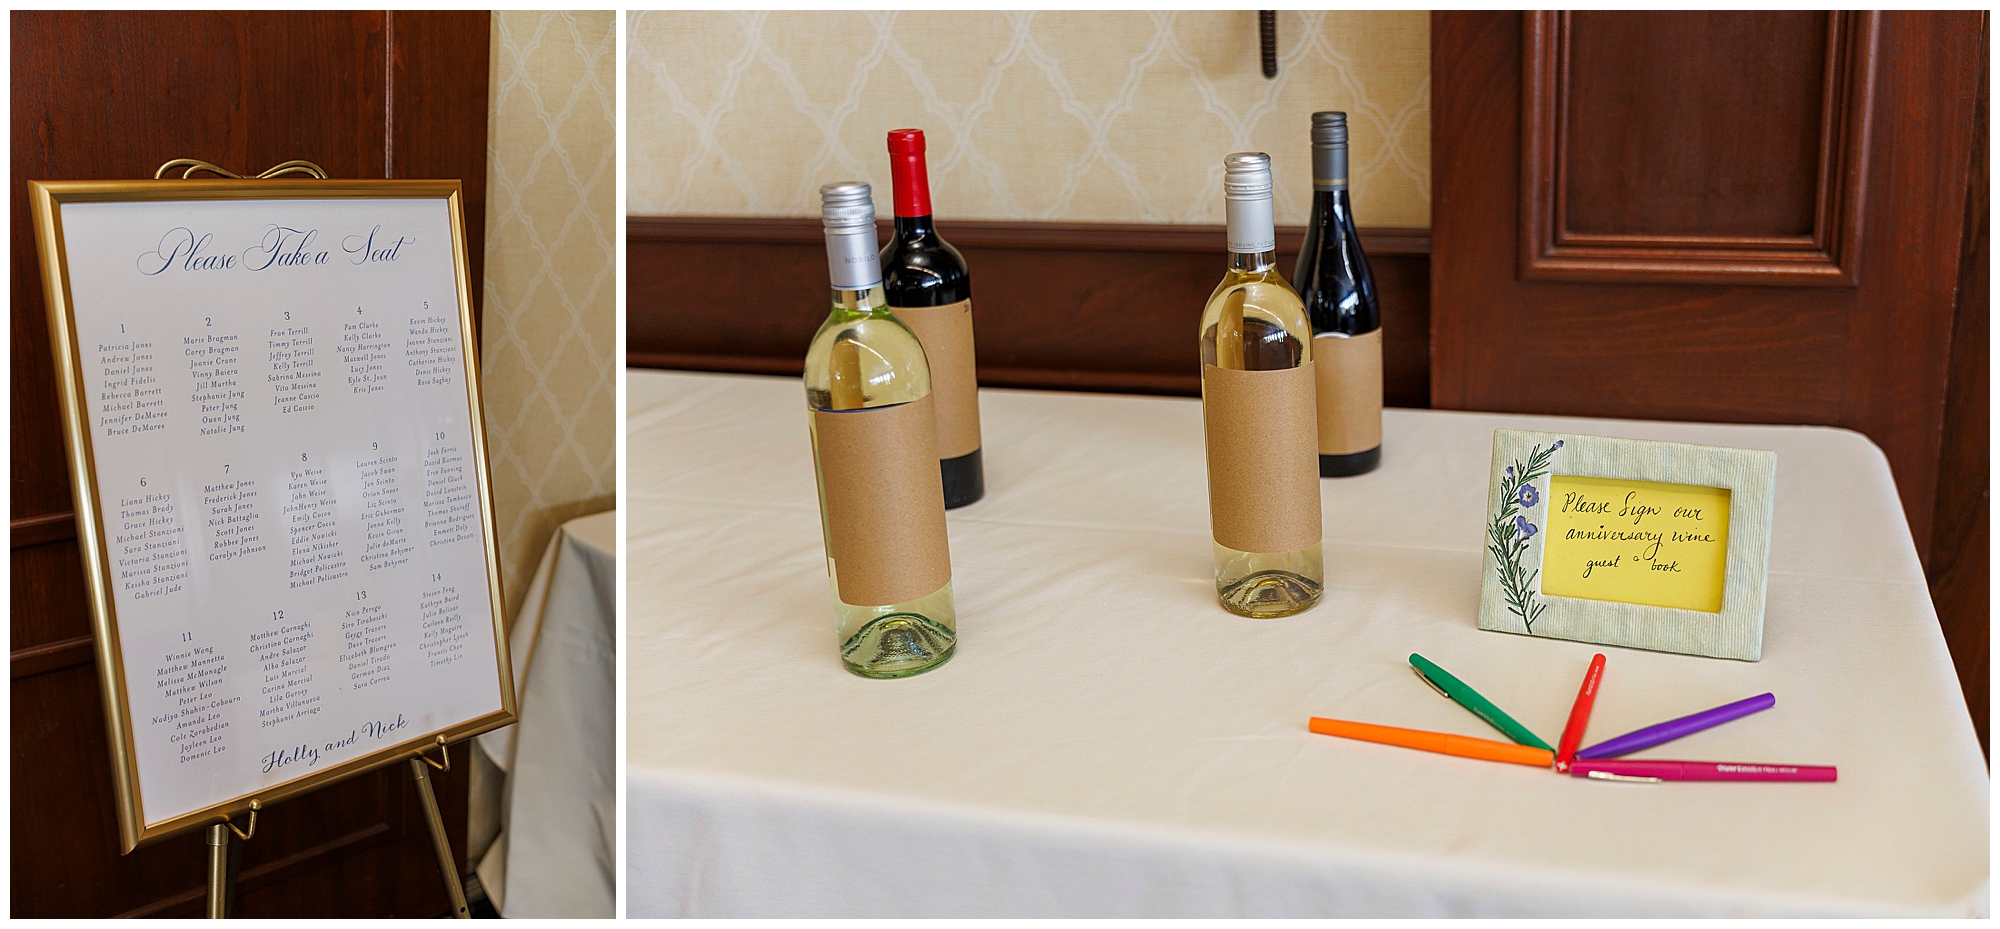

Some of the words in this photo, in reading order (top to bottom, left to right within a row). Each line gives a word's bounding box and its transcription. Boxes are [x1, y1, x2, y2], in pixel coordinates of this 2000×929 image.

[136, 226, 237, 275] Please
[242, 223, 318, 271] Take
[315, 249, 330, 265] a
[341, 224, 416, 266] Seat
[845, 254, 876, 264] NOBILO
[357, 306, 362, 314] 4
[205, 317, 212, 326] 2
[284, 312, 290, 320] 3
[428, 316, 446, 324] Hickey
[121, 324, 125, 333] 1
[288, 327, 308, 335] Terrill
[430, 326, 448, 335] Hickey
[268, 340, 290, 348] Timmy
[292, 338, 313, 346] Terrill
[344, 334, 359, 342] Kelly
[406, 338, 425, 347] Jeanne
[99, 344, 129, 352] Patricia
[132, 342, 152, 351] Jones
[336, 345, 355, 353] Nancy
[357, 342, 391, 351] Harrington
[406, 347, 428, 356] Anthony
[101, 356, 129, 364] Andrew
[132, 354, 152, 362] Jones
[269, 351, 291, 361] Jeffrey
[294, 349, 314, 357] Terrill
[371, 353, 386, 361] Jones
[104, 367, 130, 376] Daniel
[132, 366, 152, 374] Jones
[273, 362, 290, 371] Kelly
[292, 360, 313, 368] Terrill
[351, 365, 364, 374] Lucy
[366, 364, 382, 372] Jones
[433, 366, 451, 374] Hickey
[104, 379, 128, 389] Ingrid
[131, 377, 155, 385] Fidelis
[268, 373, 294, 382] Sabrina
[348, 375, 361, 385] Kyle
[196, 382, 208, 392] Jill
[211, 380, 236, 388] Murtha
[353, 386, 366, 394] Kris
[368, 385, 384, 393] Jones
[102, 391, 131, 400] Rebecca
[135, 388, 162, 397] Barrett
[192, 392, 226, 402] Stephanie
[228, 391, 244, 399] Jung
[103, 403, 133, 412] Michael
[137, 400, 163, 408] Barrett
[202, 404, 219, 412] Peter
[222, 403, 238, 412] Jung
[202, 415, 221, 423] Owen
[224, 414, 240, 422] Jung
[200, 427, 227, 435] Natalie
[229, 424, 245, 434] Jung
[436, 432, 445, 440] 10
[372, 442, 378, 450] 9
[302, 453, 307, 461] 8
[356, 459, 377, 467] Lauren
[225, 465, 230, 474] 7
[140, 477, 147, 486] 6
[204, 483, 234, 493] Matthew
[236, 480, 255, 490] Jones
[364, 480, 374, 489] Jen
[204, 493, 237, 504] Frederick
[239, 491, 257, 500] Jones
[121, 509, 149, 518] Thomas
[153, 504, 173, 514] Brady
[212, 505, 232, 514] Sarah
[234, 503, 253, 512] Jones
[1562, 492, 1611, 513] Please
[1618, 491, 1661, 525] Sign
[1674, 507, 1703, 520] our
[124, 521, 146, 530] Grace
[149, 516, 173, 525] Hickey
[228, 513, 259, 524] Battaglia
[387, 517, 401, 526] Kelly
[116, 533, 146, 543] Michael
[149, 526, 184, 538] Stanziani
[216, 528, 234, 537] Scott
[236, 525, 254, 535] Jones
[124, 546, 142, 554] Sara
[144, 538, 180, 550] Stanziani
[1566, 525, 1663, 560] anniversary
[1672, 528, 1715, 542] wine
[119, 556, 149, 566] Victoria
[153, 548, 187, 561] Stanziani
[210, 551, 237, 561] Carolyn
[239, 545, 266, 557] Johnson
[121, 569, 150, 578] Marissa
[154, 560, 188, 573] Stanziani
[290, 568, 313, 578] Bridget
[315, 561, 346, 572] Policastro
[1582, 555, 1620, 578] guest
[1651, 559, 1681, 572] book
[125, 580, 150, 590] Keisha
[153, 572, 188, 585] Stanziani
[290, 578, 315, 589] Michael
[317, 571, 348, 583] Policastro
[432, 573, 442, 582] 14
[135, 587, 163, 599] Gabriel
[165, 584, 182, 595] Jude
[356, 591, 366, 600] 13
[273, 611, 284, 620] 12
[250, 630, 278, 641] Matthew
[281, 621, 311, 634] Carnaghi
[440, 624, 462, 635] Maguire
[182, 632, 192, 642] 11
[157, 676, 185, 688] Melissa
[187, 665, 227, 680] McMonagle
[351, 669, 374, 679] German
[377, 665, 390, 673] Diaz
[165, 685, 196, 698] Matthew
[199, 678, 223, 689] Wilson
[353, 682, 367, 690] Sara
[370, 676, 390, 685] Correa
[179, 696, 197, 705] Peter
[200, 691, 212, 700] Leo
[177, 717, 205, 729] Amanda
[209, 712, 220, 721] Leo
[170, 734, 187, 743] Cole
[190, 722, 229, 738] Zorabedian
[262, 745, 320, 774] Holly
[325, 731, 359, 752] and
[362, 714, 409, 739] Nick
[181, 750, 211, 763] Domenic
[213, 745, 226, 754] Leo
